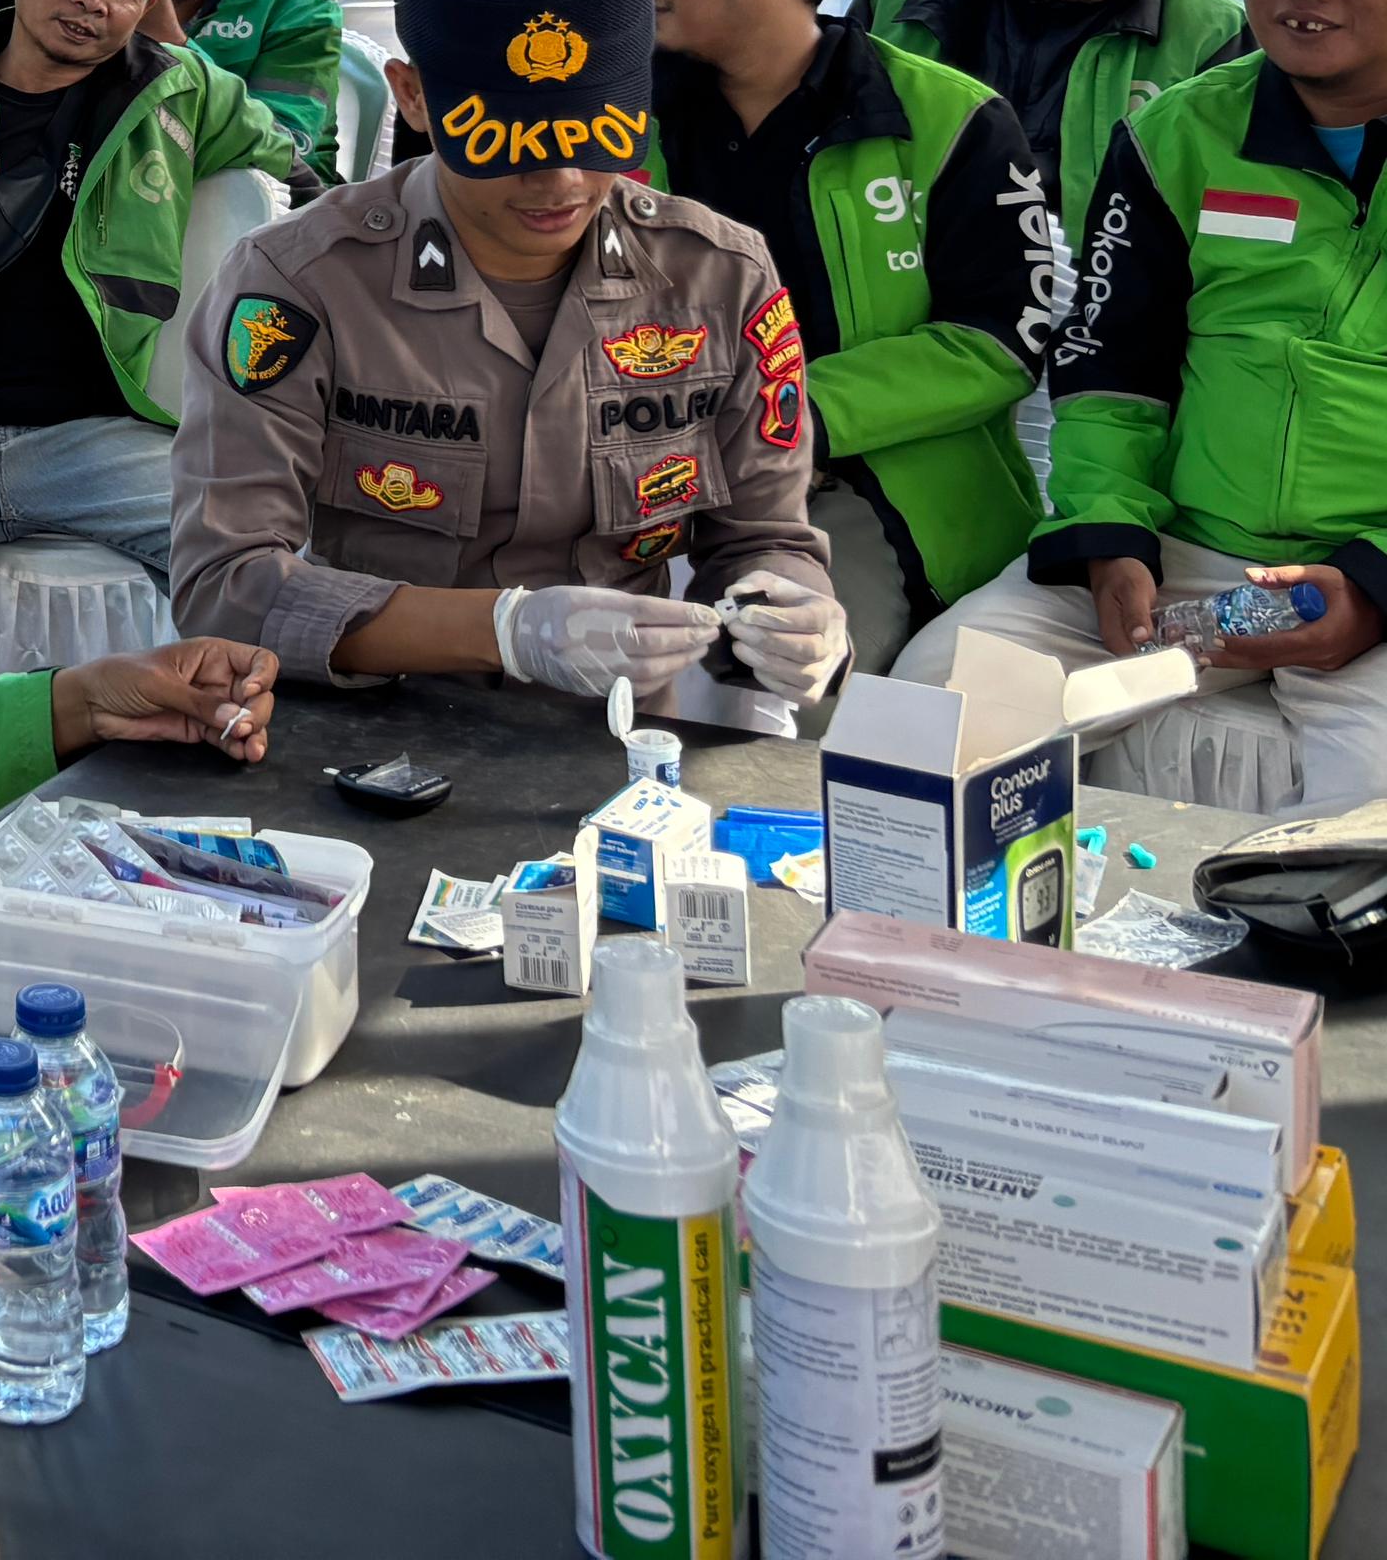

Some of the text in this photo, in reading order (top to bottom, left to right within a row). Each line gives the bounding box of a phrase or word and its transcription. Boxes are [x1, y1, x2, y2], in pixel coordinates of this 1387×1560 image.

[196, 15, 254, 38] rab
[442, 94, 647, 164] DOKPOL
[336, 387, 481, 442] BINTARA
[601, 387, 721, 436] POLRI
[990, 758, 1051, 800] Contour
[990, 792, 1023, 831] plus
[603, 1251, 675, 1542] OXYCAN
[692, 1231, 723, 1540] Pure oxygen in practical can
